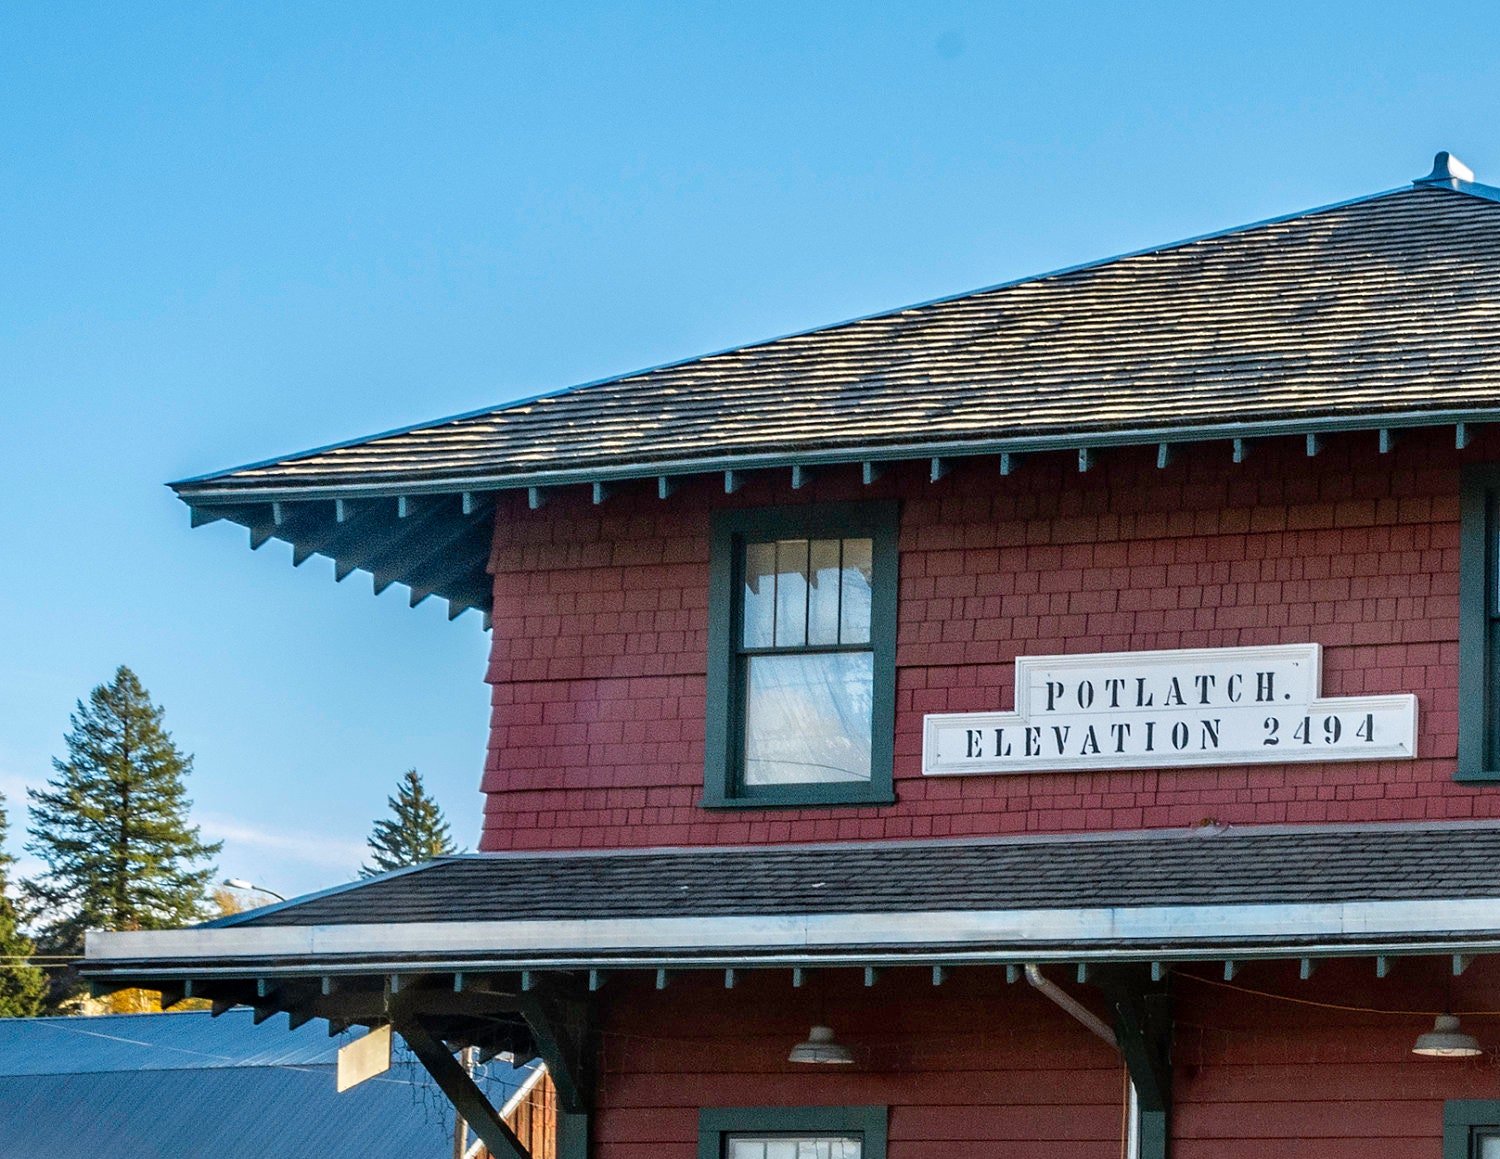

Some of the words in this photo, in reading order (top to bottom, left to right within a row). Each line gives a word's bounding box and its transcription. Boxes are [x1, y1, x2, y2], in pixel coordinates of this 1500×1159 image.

[1045, 671, 1292, 712] POTLATCH.
[966, 719, 1222, 759] ELEVATION
[1263, 713, 1375, 747] 2494
